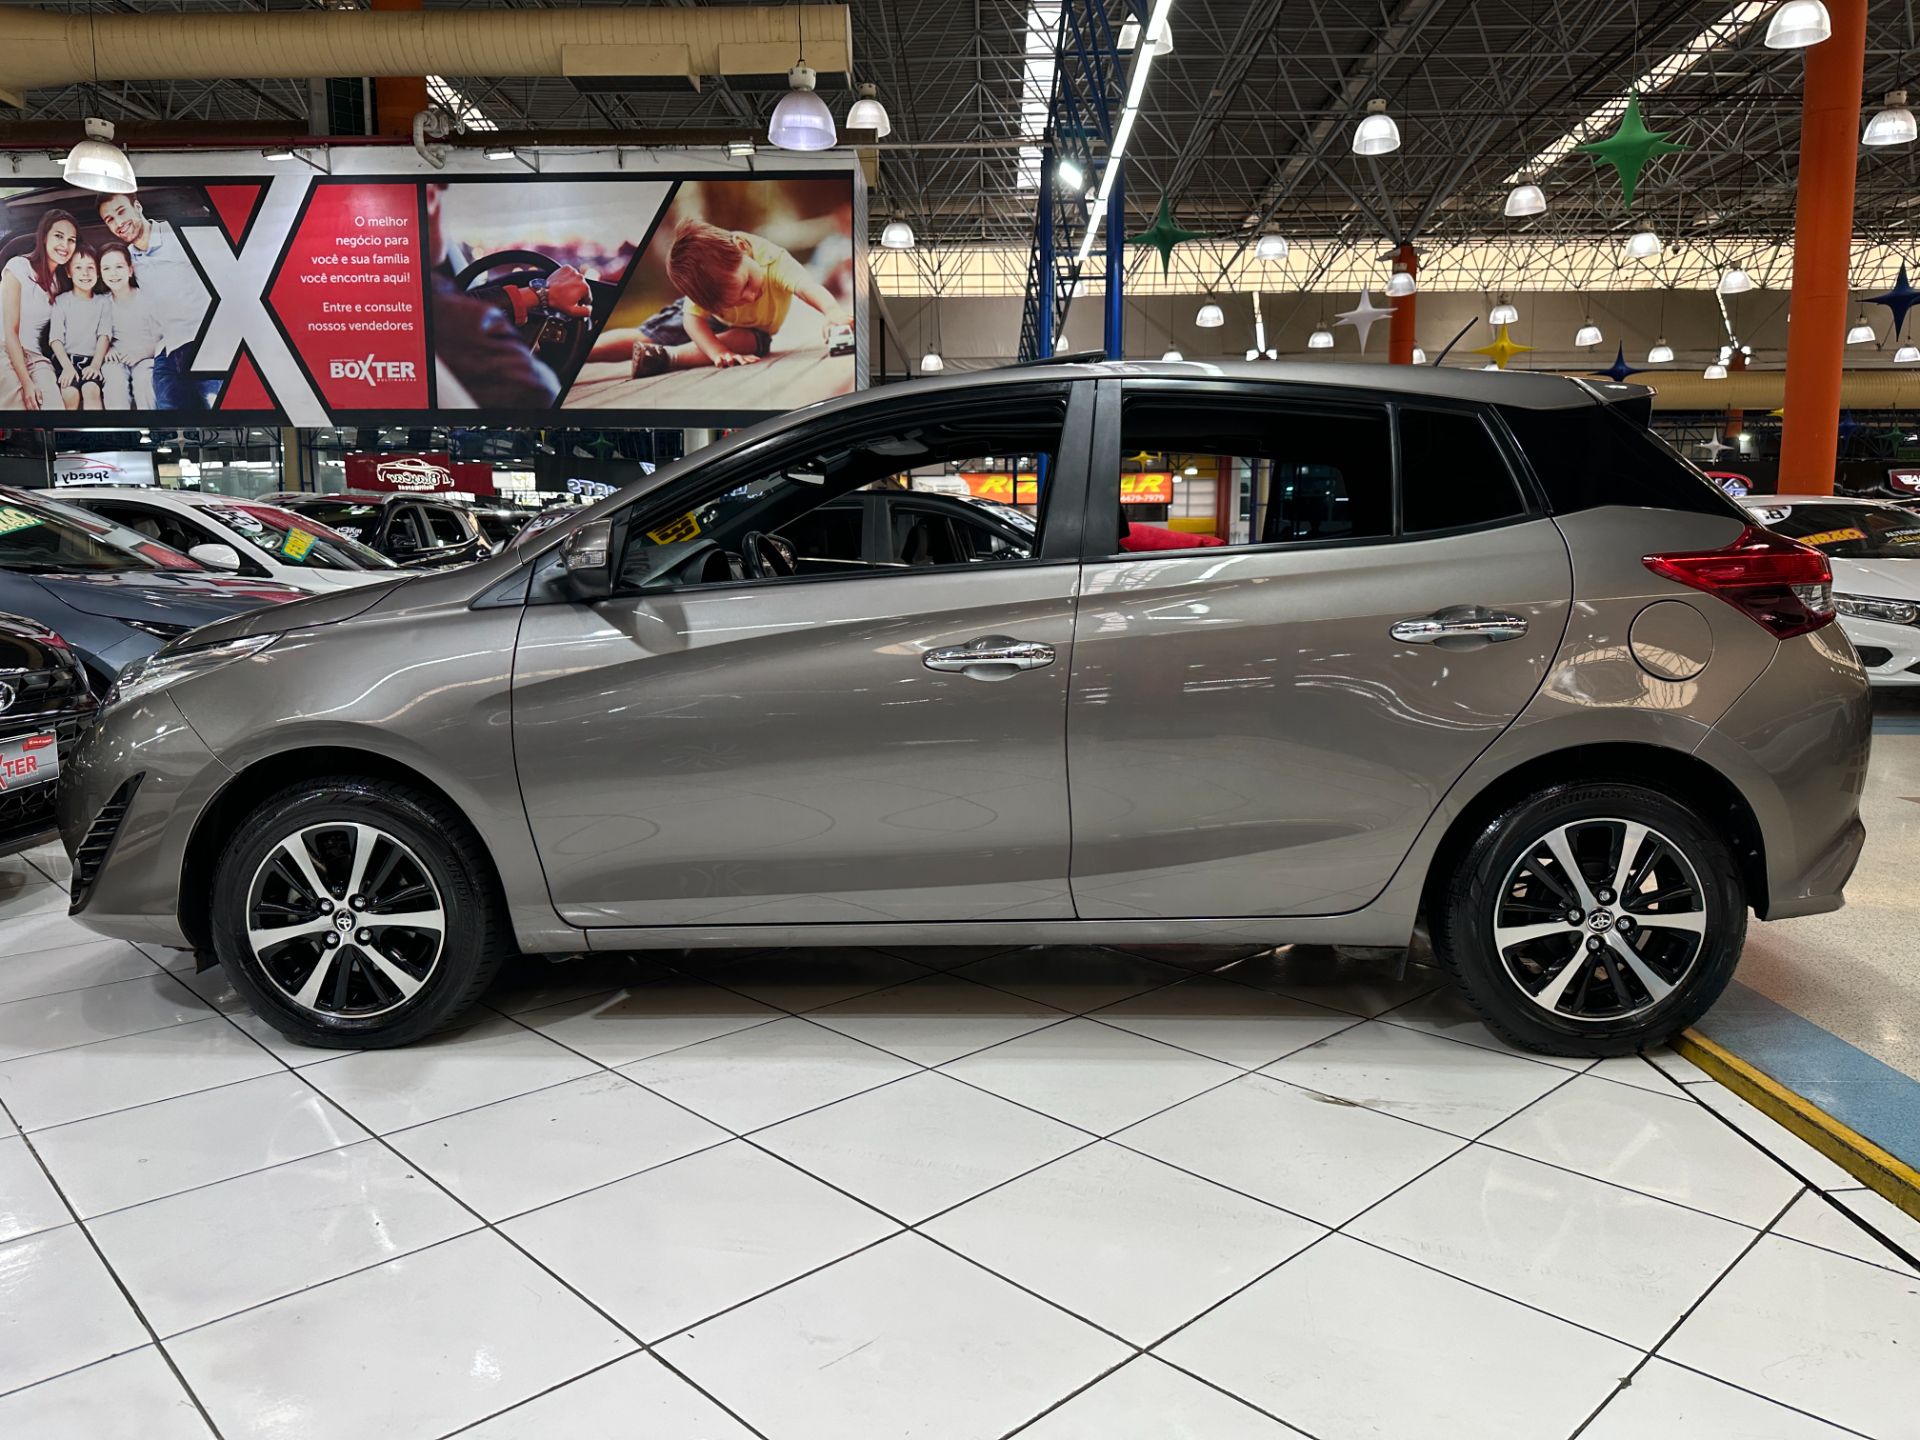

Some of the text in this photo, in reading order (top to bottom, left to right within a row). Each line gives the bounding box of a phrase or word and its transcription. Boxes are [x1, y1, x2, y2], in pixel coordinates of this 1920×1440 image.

[354, 215, 408, 227] O melhor
[336, 234, 409, 248] negócio para
[311, 253, 410, 265] você e sua família
[300, 272, 411, 285] você encontra aqui!
[323, 302, 413, 313] Entre e consulte
[308, 320, 414, 332] nossos vendedores
[330, 353, 416, 387] BOXTER
